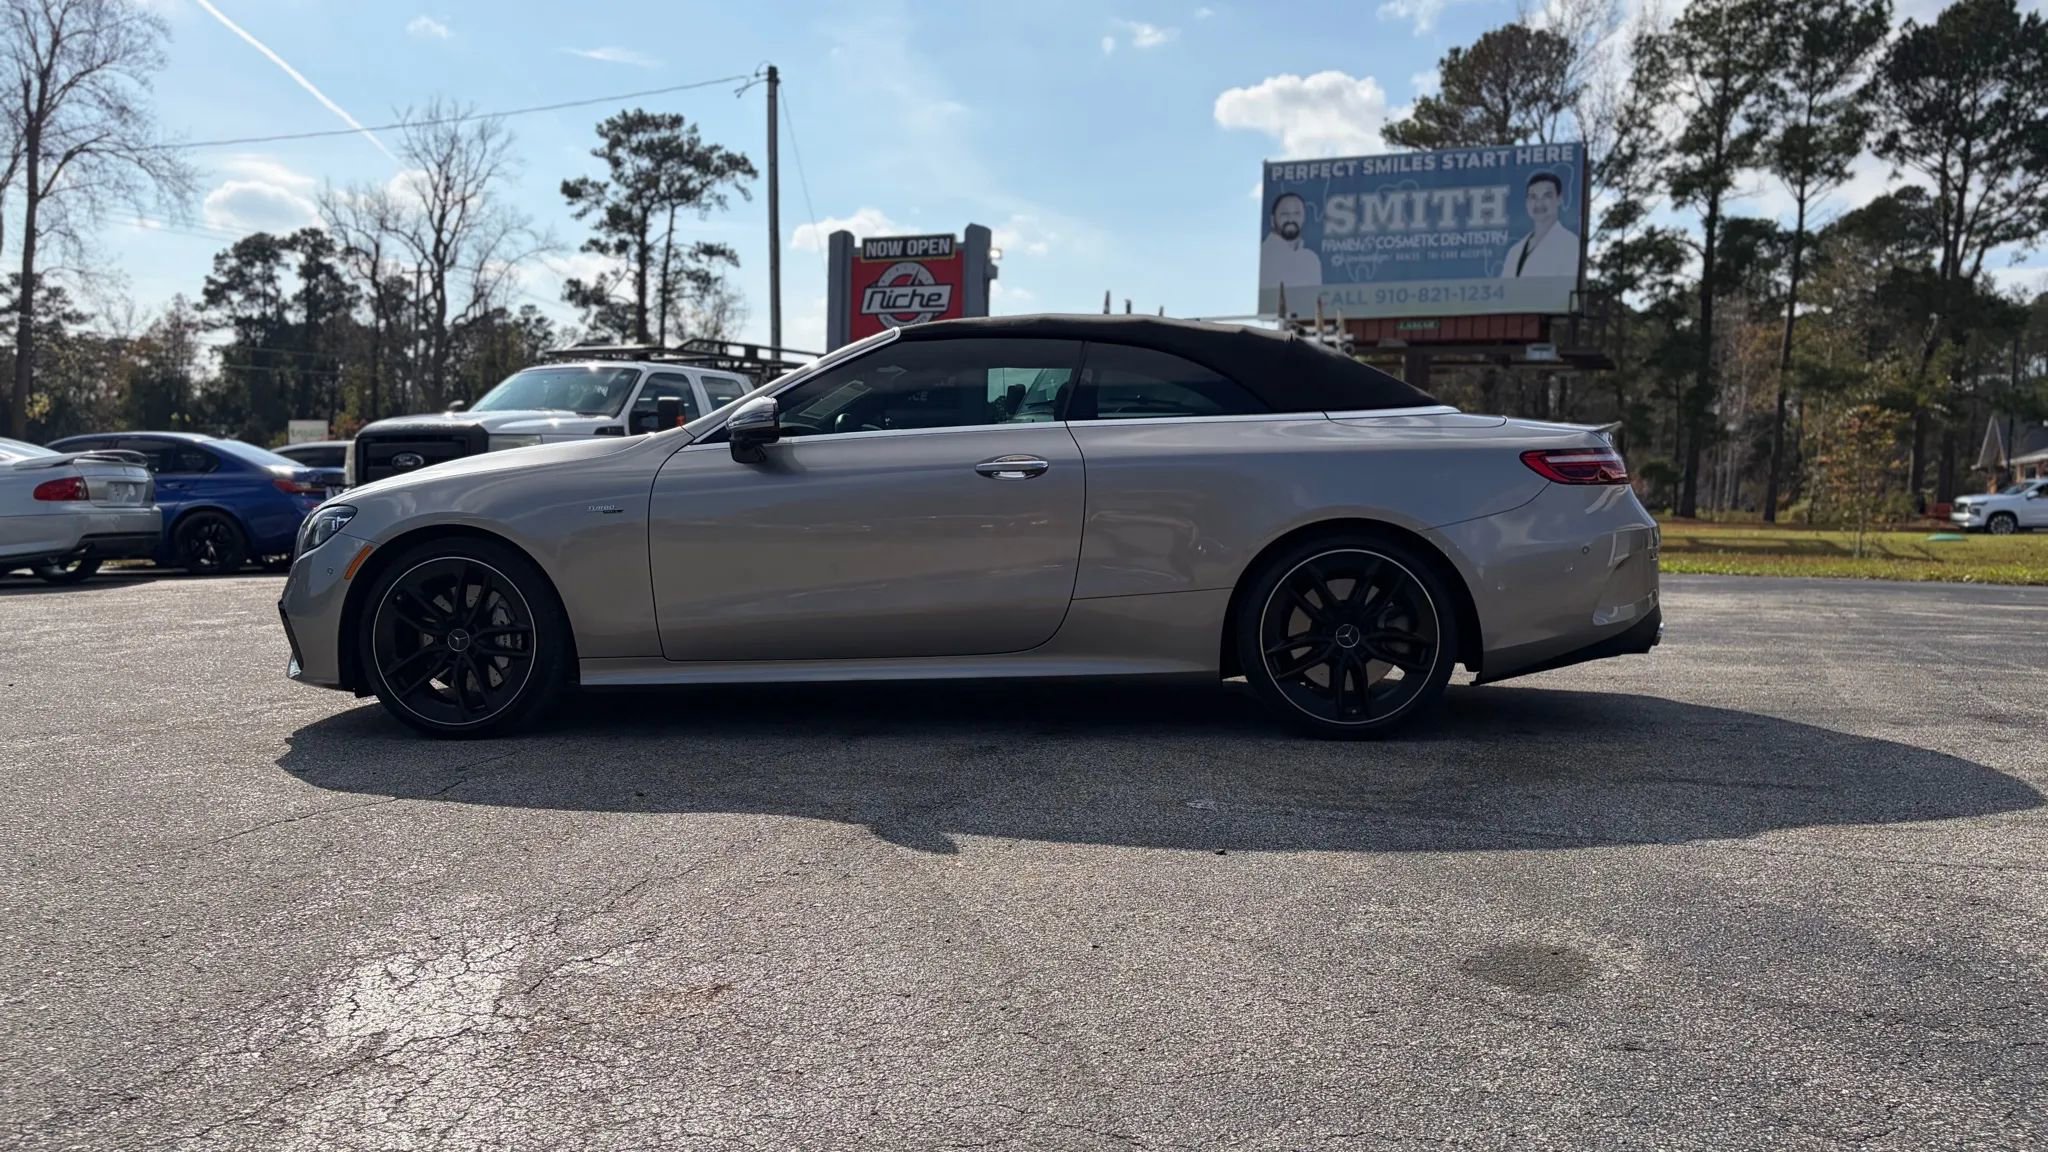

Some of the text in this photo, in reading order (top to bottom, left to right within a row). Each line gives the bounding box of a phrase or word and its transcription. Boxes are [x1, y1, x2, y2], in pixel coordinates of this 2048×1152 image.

[1271, 145, 1574, 181] PERFECT SMILES START HERE
[1324, 184, 1510, 235] SMITH
[865, 237, 950, 258] NOW OPEN
[1376, 232, 1439, 249] COSMETIC
[1440, 229, 1509, 247] DENTISTRY
[1317, 285, 1505, 306] CALL 910-821-1234
